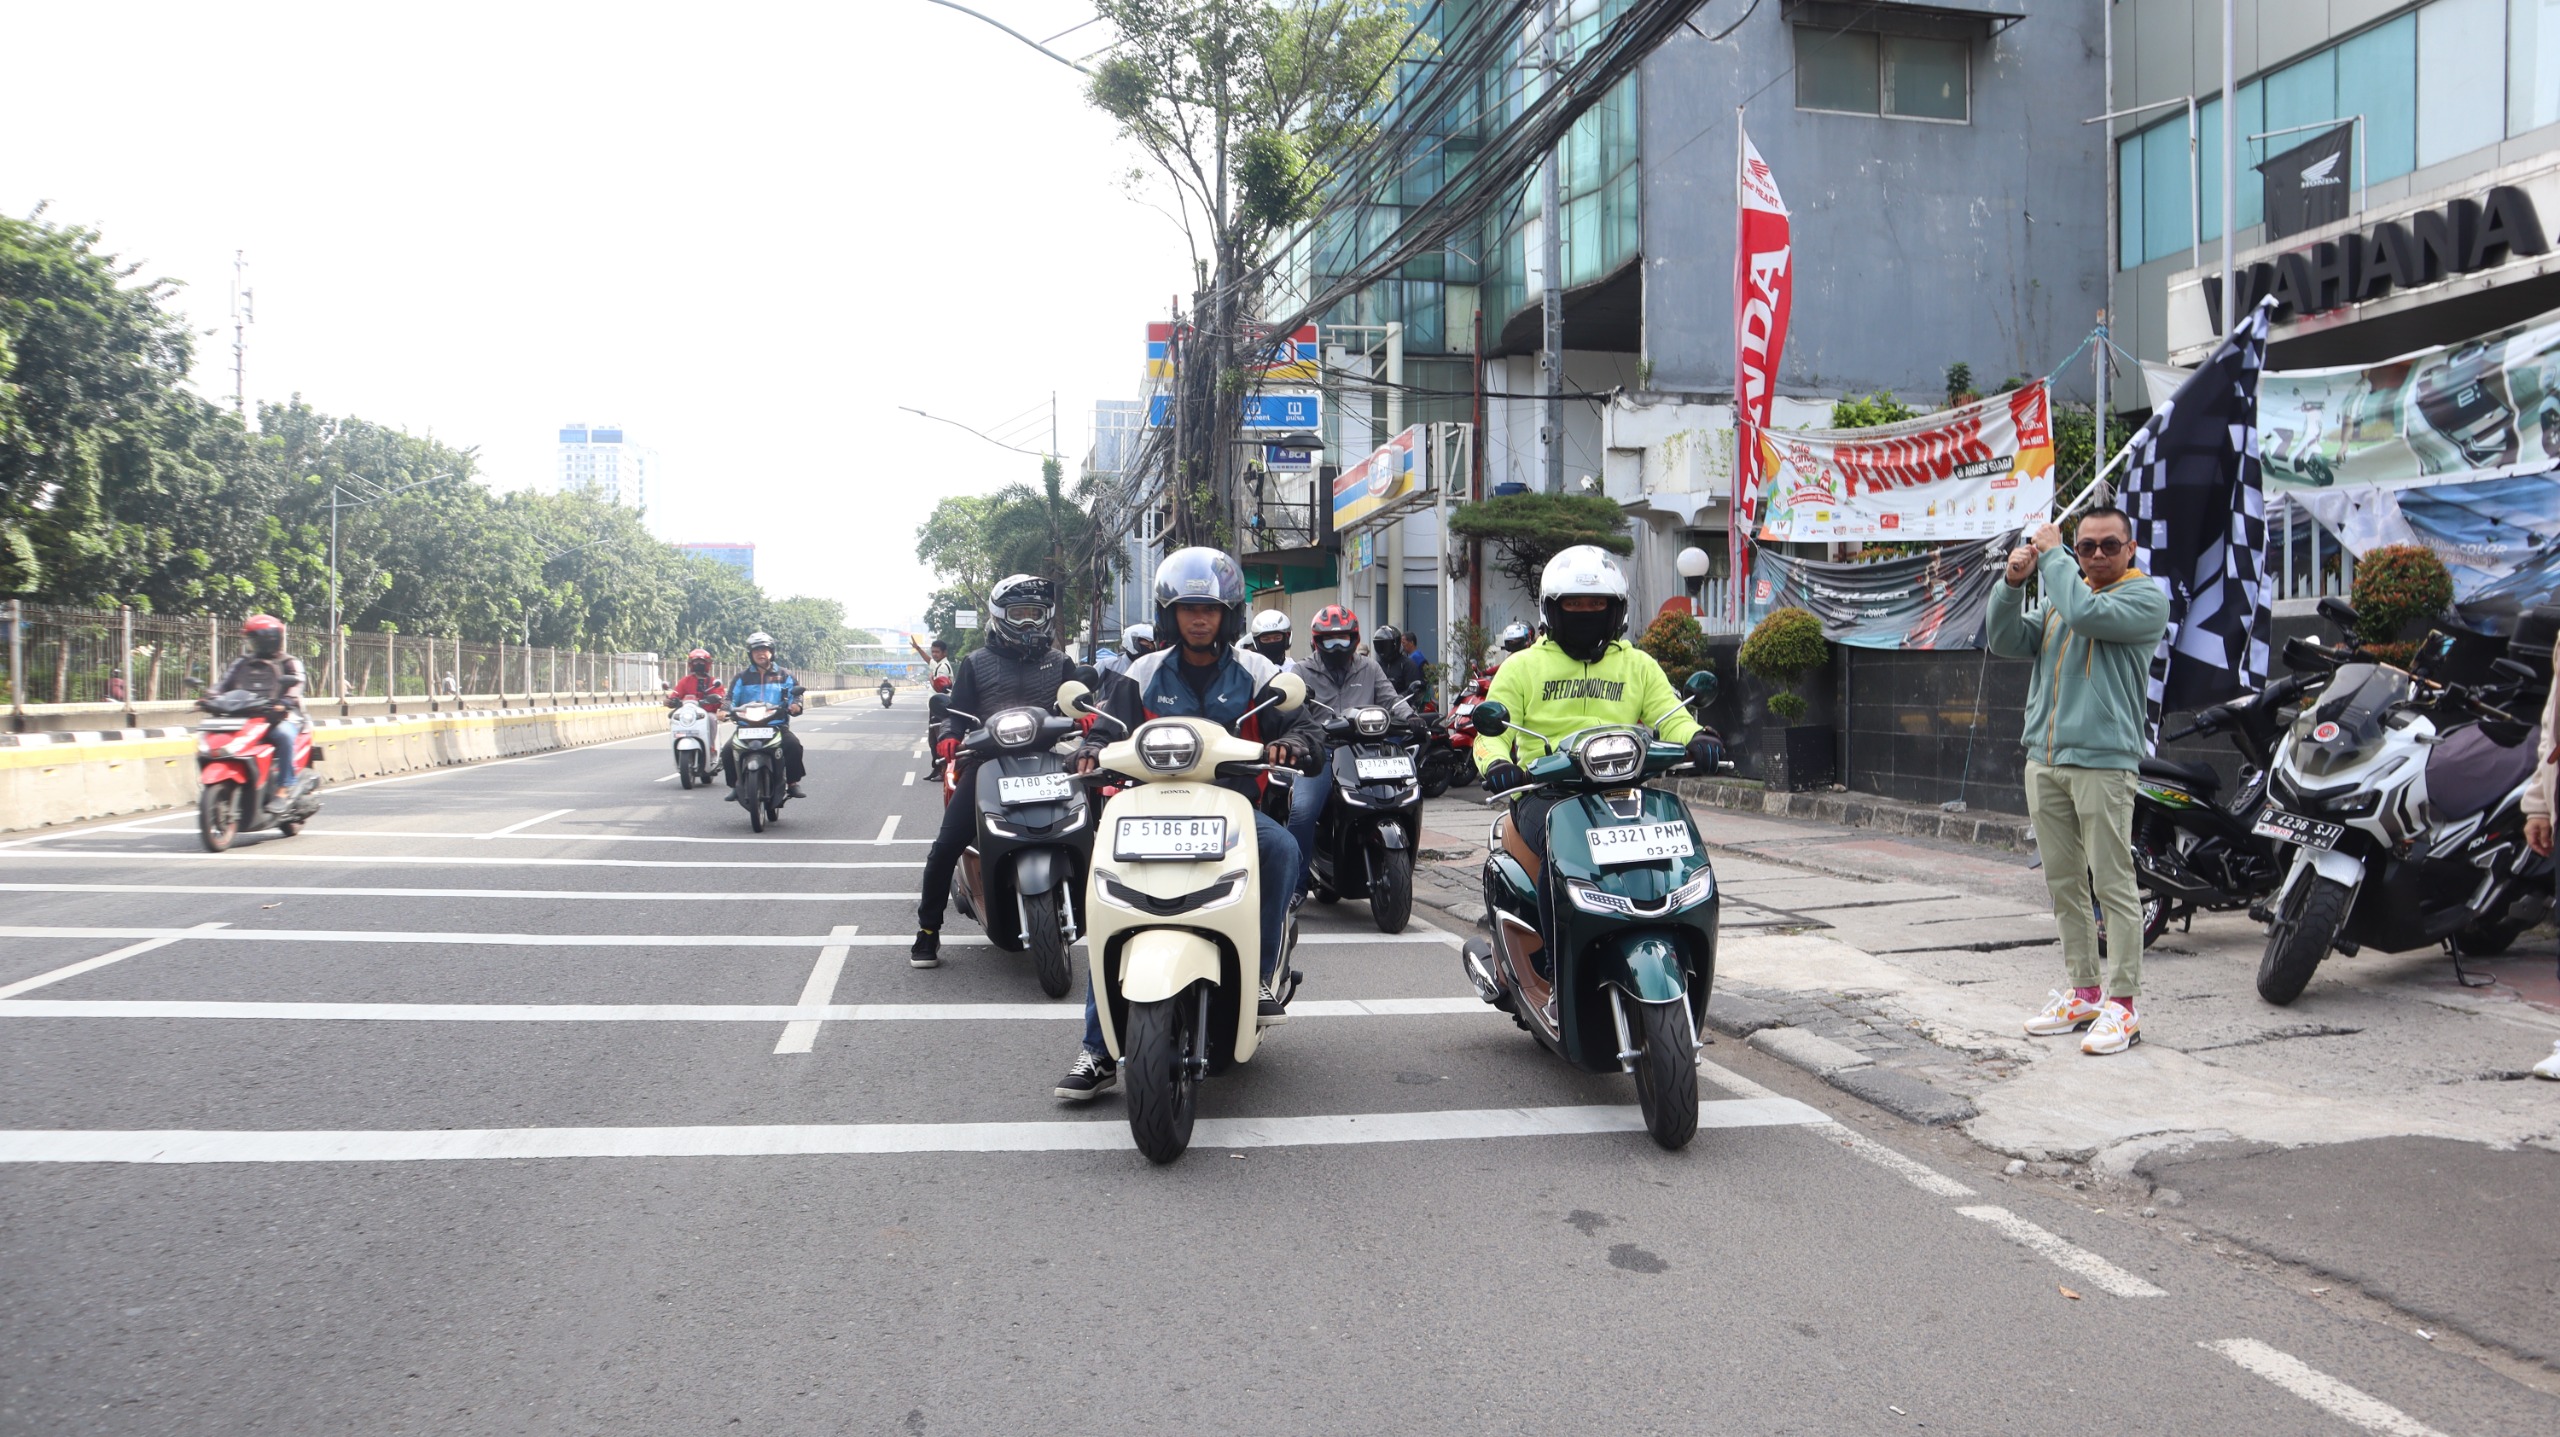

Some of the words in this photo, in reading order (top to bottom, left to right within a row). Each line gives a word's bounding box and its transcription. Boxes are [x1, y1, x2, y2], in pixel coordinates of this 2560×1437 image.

[2301, 176, 2342, 189] HONDA
[2202, 185, 2551, 336] WAHANA
[1741, 244, 1790, 537] HNDA
[1285, 414, 1305, 422] pulsa
[1288, 450, 1306, 459] BCA
[1833, 416, 1993, 497] PEMUDIK
[1957, 469, 1965, 478] di
[1965, 462, 1988, 476] AHASS
[1988, 457, 2013, 473] SIAGA
[2459, 543, 2508, 555] COLOR
[1542, 679, 1572, 701] SPEED
[1002, 780, 1009, 790] B
[1014, 777, 1041, 788] 4180
[1122, 822, 1131, 836] B
[1142, 822, 1182, 836] 5186
[1190, 821, 1220, 836] BLV
[2262, 810, 2273, 821] B
[2277, 815, 2310, 831] 4236
[2314, 824, 2339, 838] SJI
[2268, 824, 2291, 837] PERS
[1590, 832, 1601, 846] B
[1608, 828, 1647, 844] 3321
[1654, 823, 1686, 840] PNM
